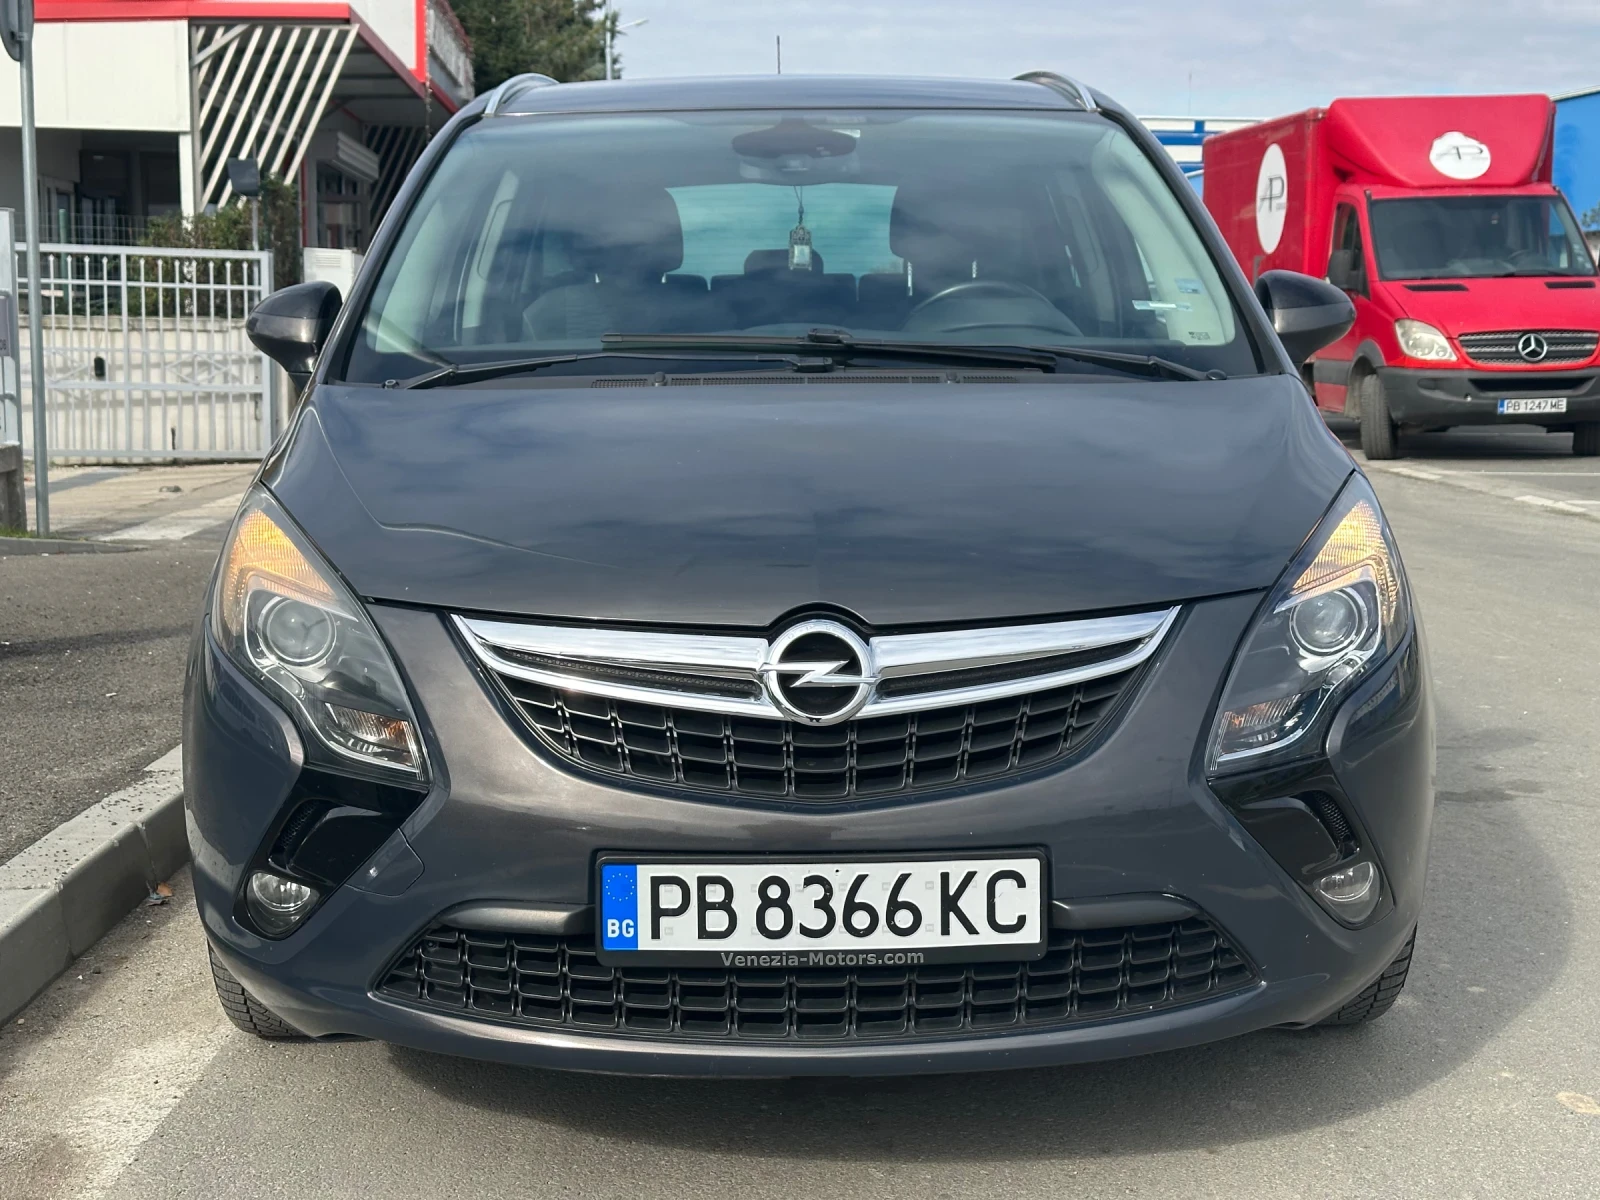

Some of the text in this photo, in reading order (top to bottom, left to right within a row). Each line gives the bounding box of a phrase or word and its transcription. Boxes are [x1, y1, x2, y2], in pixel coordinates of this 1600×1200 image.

[1506, 400, 1565, 411] PB 1247 ME
[650, 870, 1027, 940] PB 8366 KC
[607, 918, 635, 938] BG
[720, 951, 924, 967] Venezia-Motors.com
